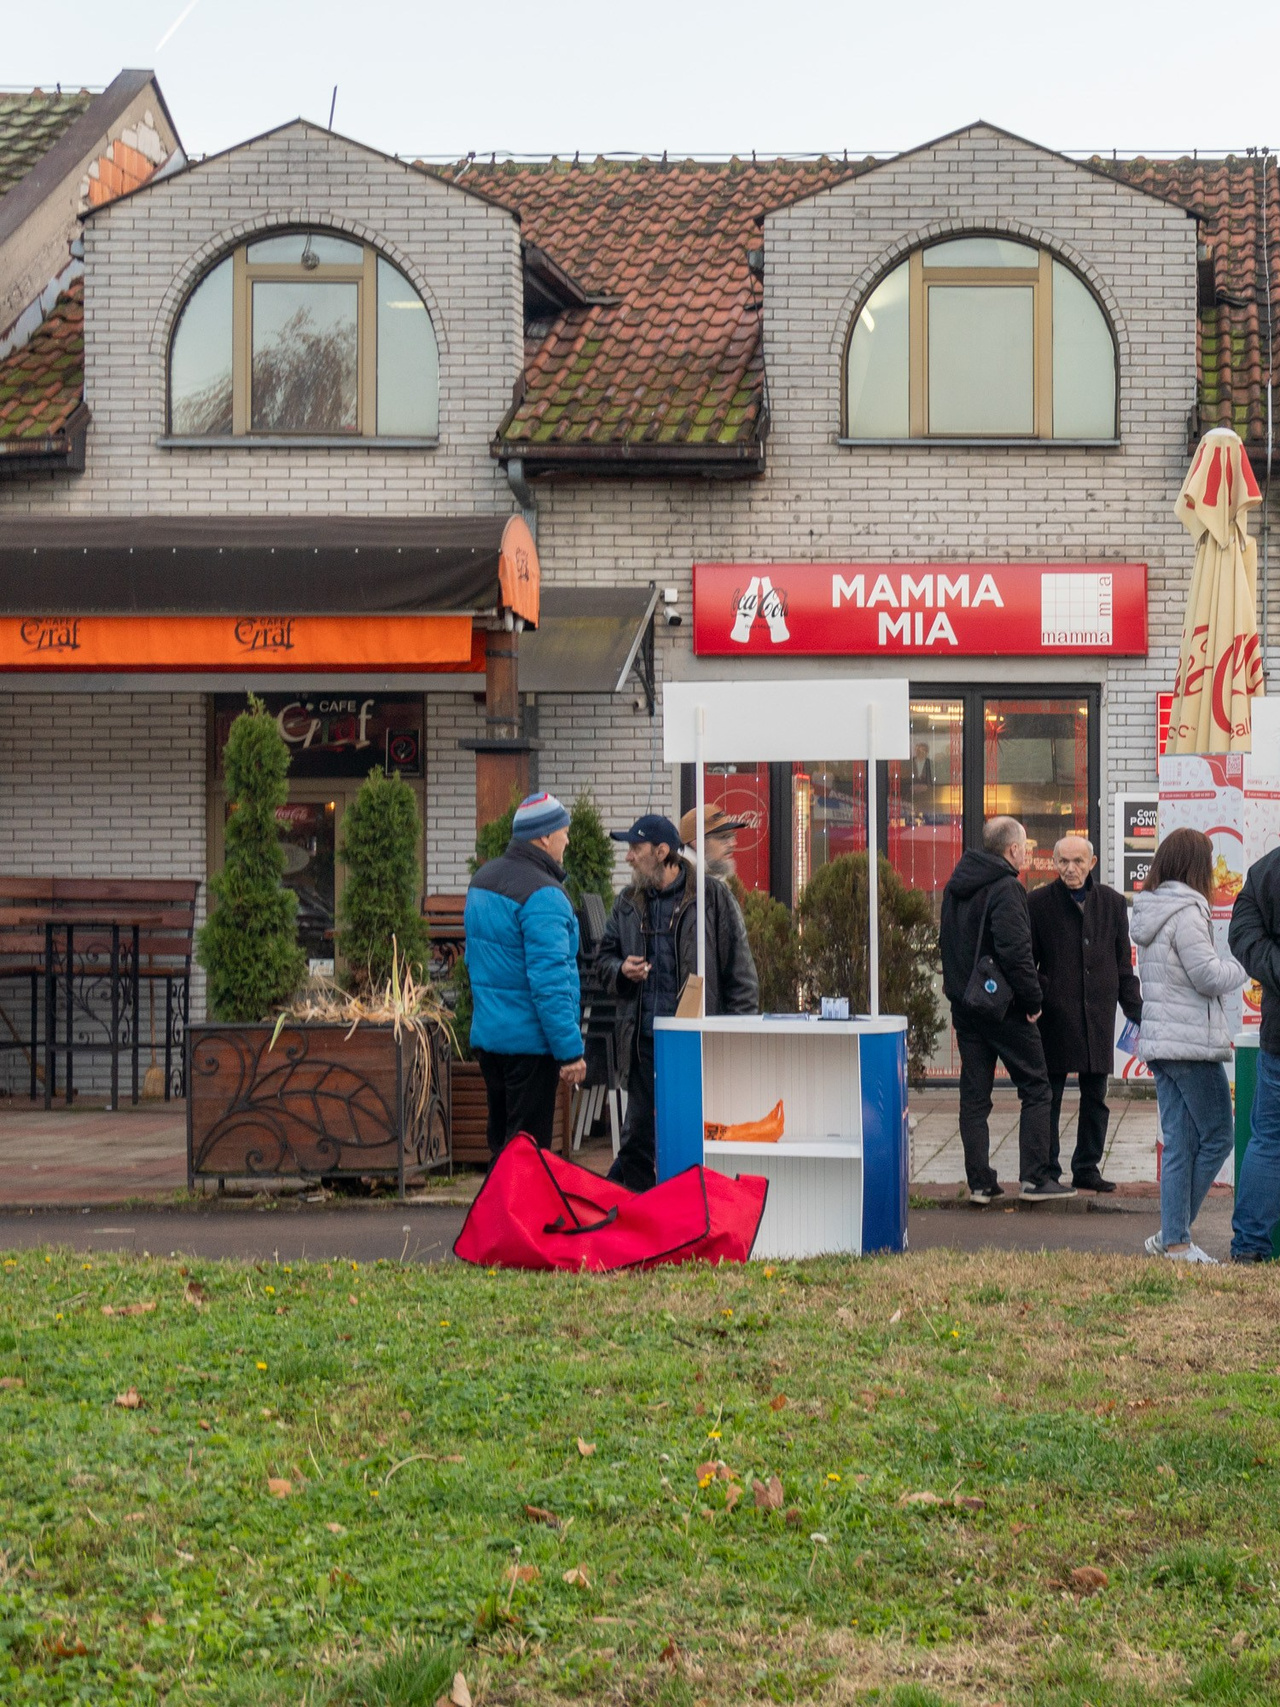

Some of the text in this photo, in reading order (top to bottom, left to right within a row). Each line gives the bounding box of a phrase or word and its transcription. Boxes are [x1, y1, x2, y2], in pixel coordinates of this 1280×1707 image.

[832, 574, 1004, 608] MAMMA
[1099, 576, 1112, 616] mia
[20, 617, 82, 652] Graf
[234, 617, 297, 652] Graf
[259, 618, 286, 626] CAFE
[878, 611, 959, 646] MIA
[1042, 629, 1111, 644] mamma
[319, 700, 356, 713] CAFE
[276, 699, 375, 750] Graf
